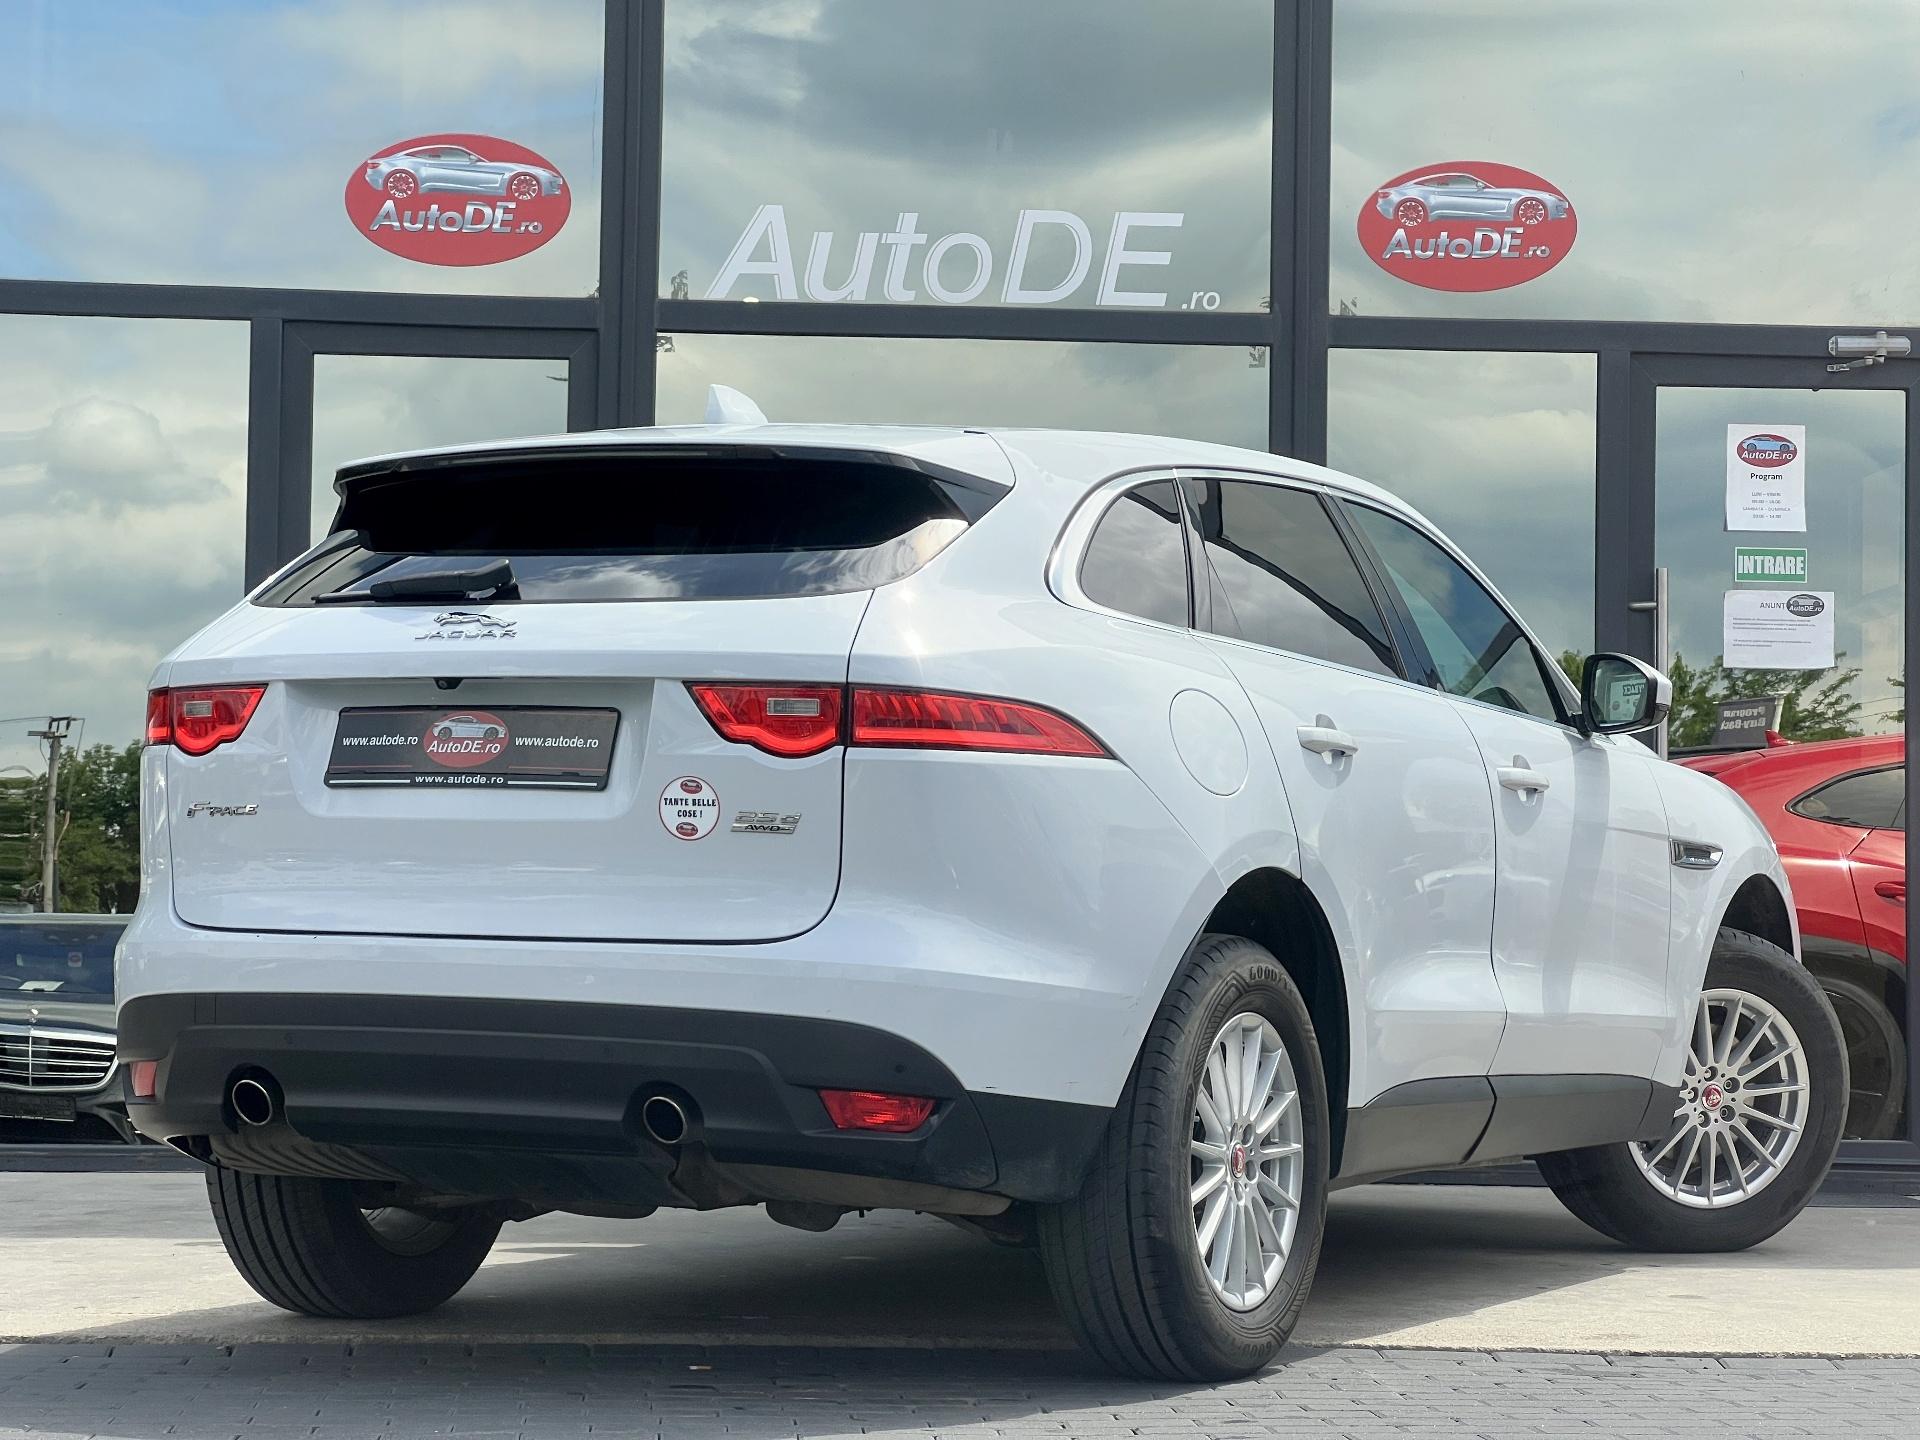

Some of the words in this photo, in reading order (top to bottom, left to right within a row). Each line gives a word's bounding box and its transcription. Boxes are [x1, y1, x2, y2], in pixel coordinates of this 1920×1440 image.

[1741, 450, 1793, 460] AutoDE.ro
[1750, 472, 1783, 481] Program
[1737, 555, 1805, 575] INTRARE
[414, 629, 518, 640] JAGUAR
[342, 733, 418, 747] www.autode.ro
[515, 734, 599, 748] www.autode.ro
[427, 740, 501, 754] AutoDE.ro
[415, 774, 504, 785] www.autode.ro
[663, 797, 689, 806] TANTE
[692, 798, 717, 807] BELLE
[677, 809, 698, 818] COSE
